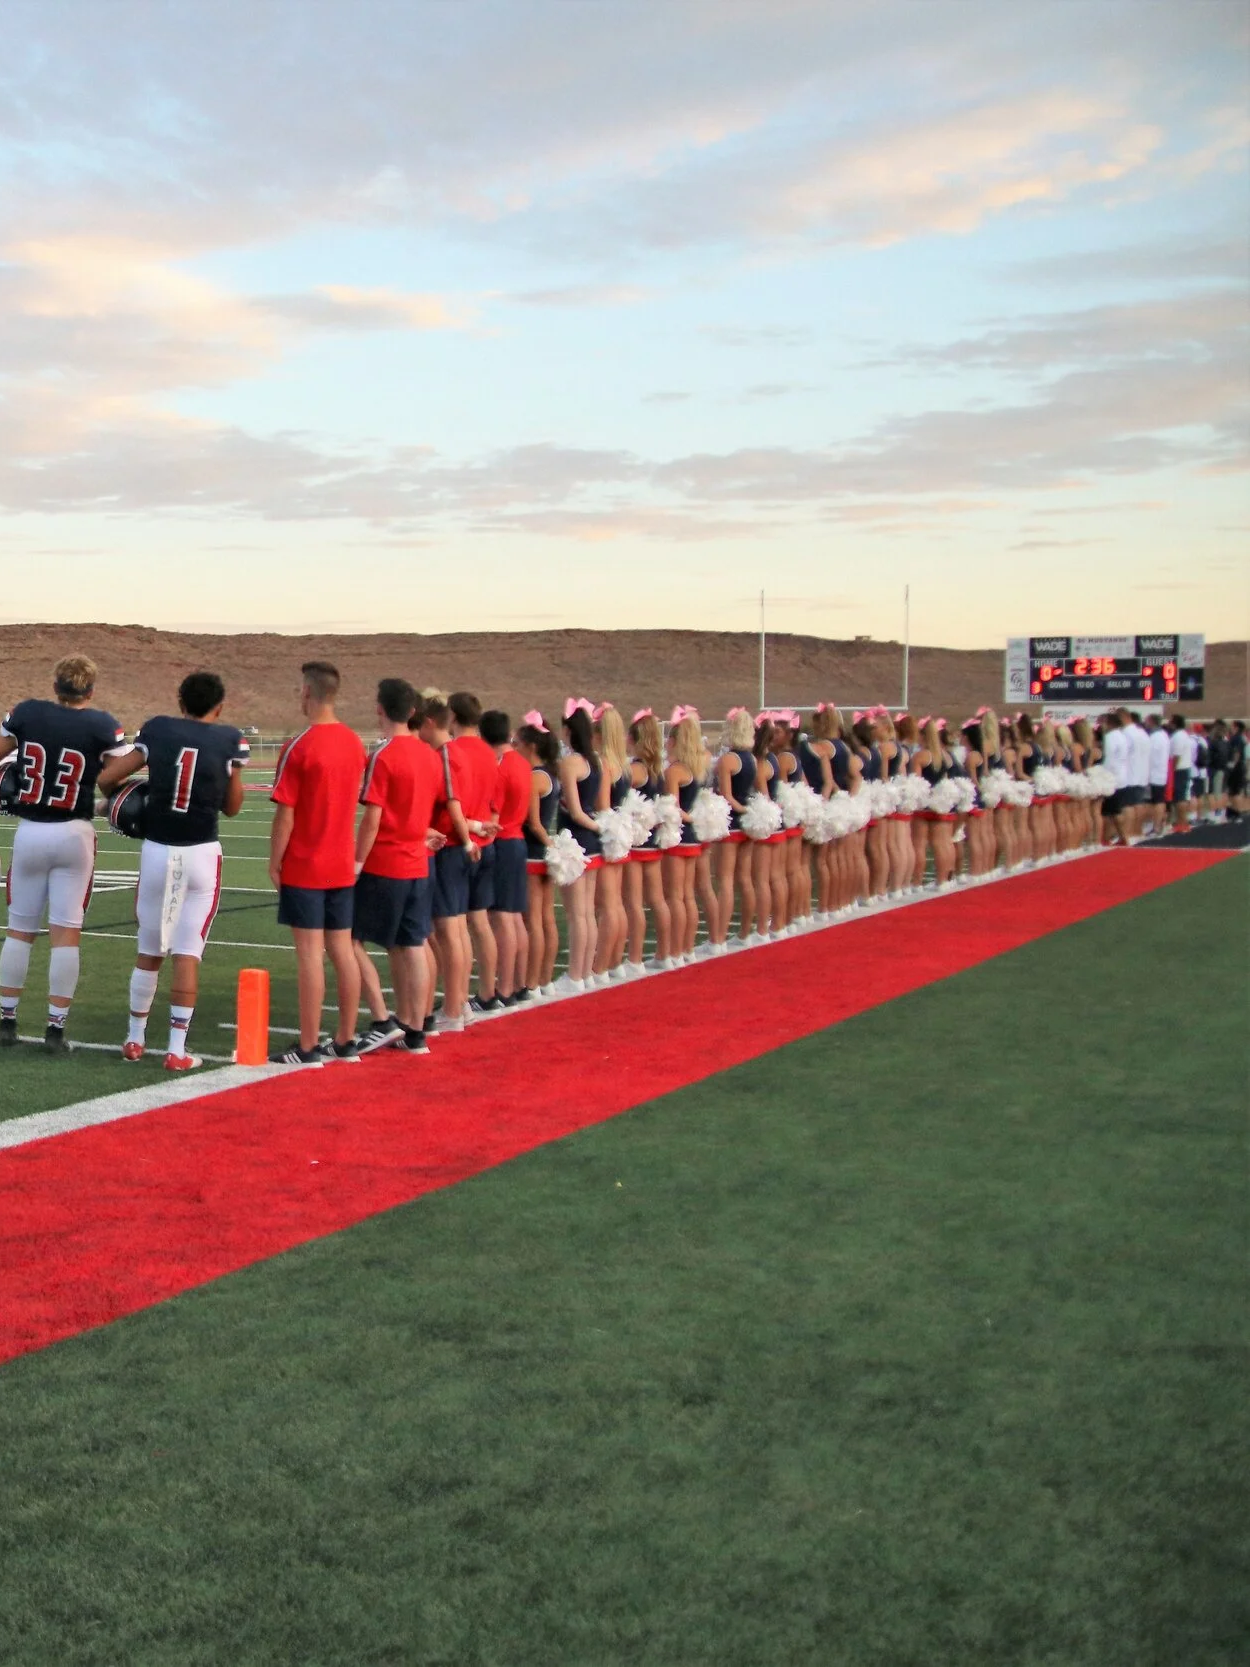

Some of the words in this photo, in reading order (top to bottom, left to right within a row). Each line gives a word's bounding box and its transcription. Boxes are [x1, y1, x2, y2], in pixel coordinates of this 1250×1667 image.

[1035, 641, 1067, 651] WADE
[1141, 639, 1174, 649] WADE
[1146, 658, 1174, 666] GUEST
[1040, 665, 1053, 681] 0
[1163, 663, 1177, 680] 0
[1049, 681, 1069, 689] DOWN
[1143, 685, 1152, 701] 1
[19, 741, 86, 811] 33
[172, 747, 198, 812] 1
